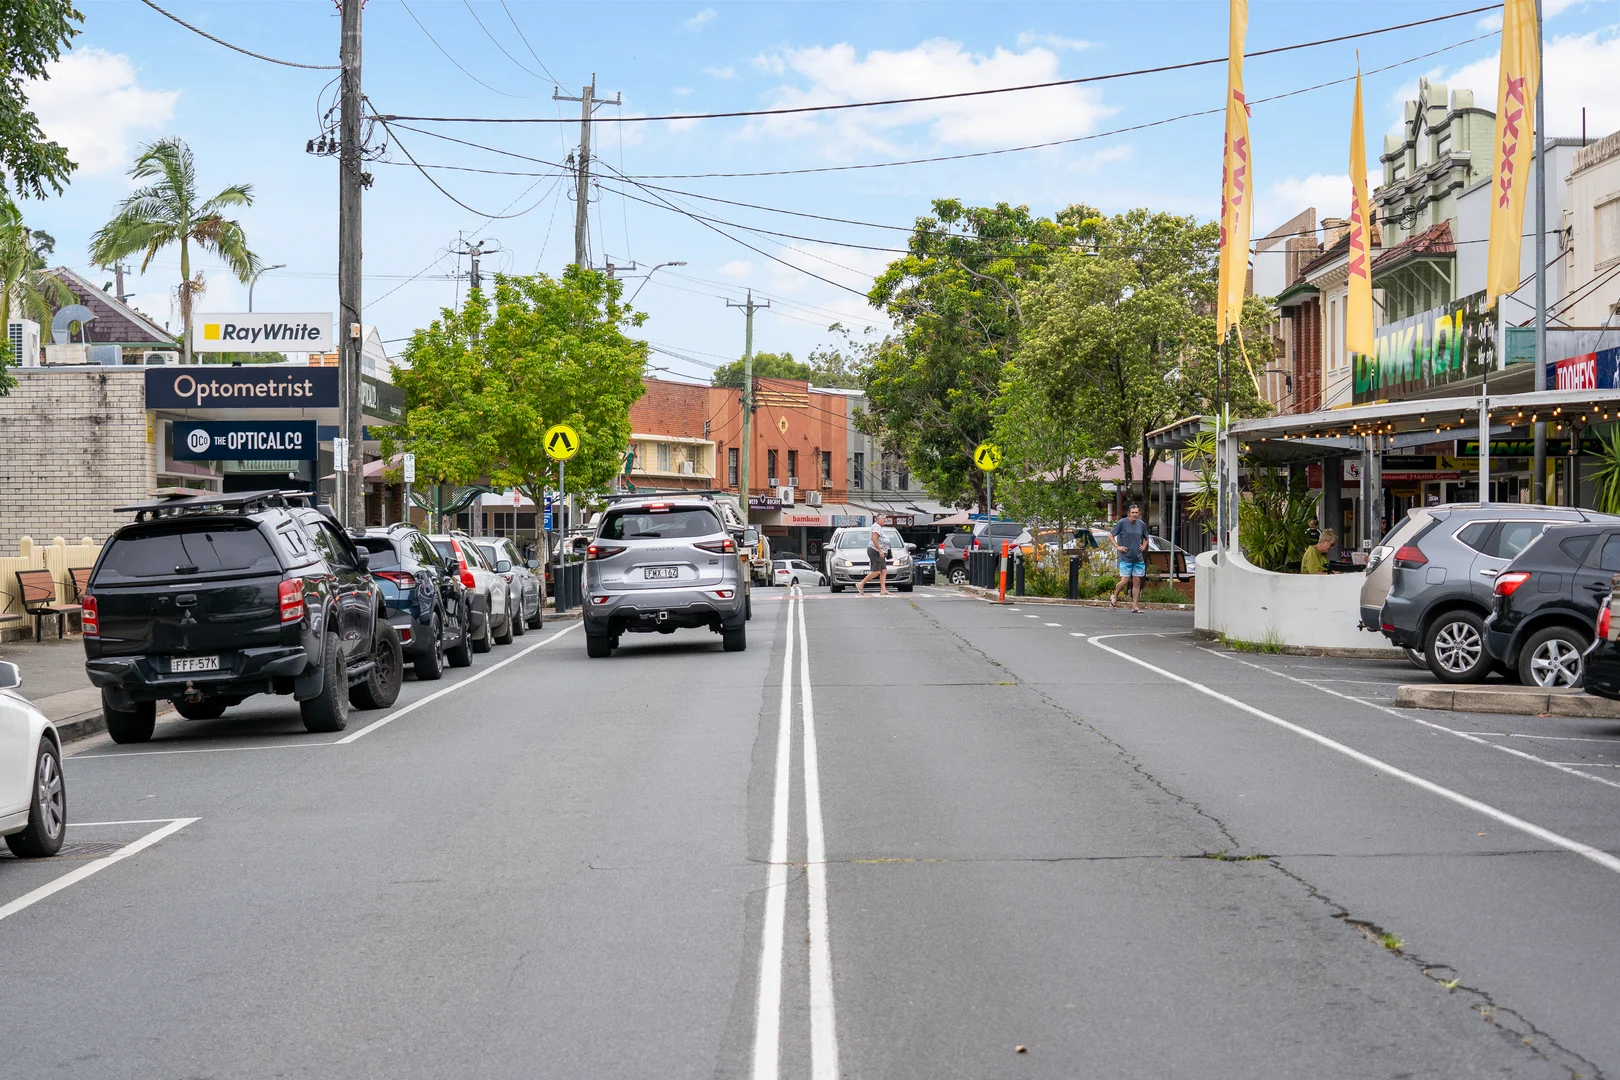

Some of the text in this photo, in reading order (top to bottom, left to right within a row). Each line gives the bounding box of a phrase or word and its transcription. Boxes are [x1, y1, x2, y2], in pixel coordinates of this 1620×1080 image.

[1557, 359, 1596, 390] TOOHEYS
[173, 374, 314, 406] Optometrist
[214, 436, 227, 446] THE
[792, 515, 821, 523] bambam
